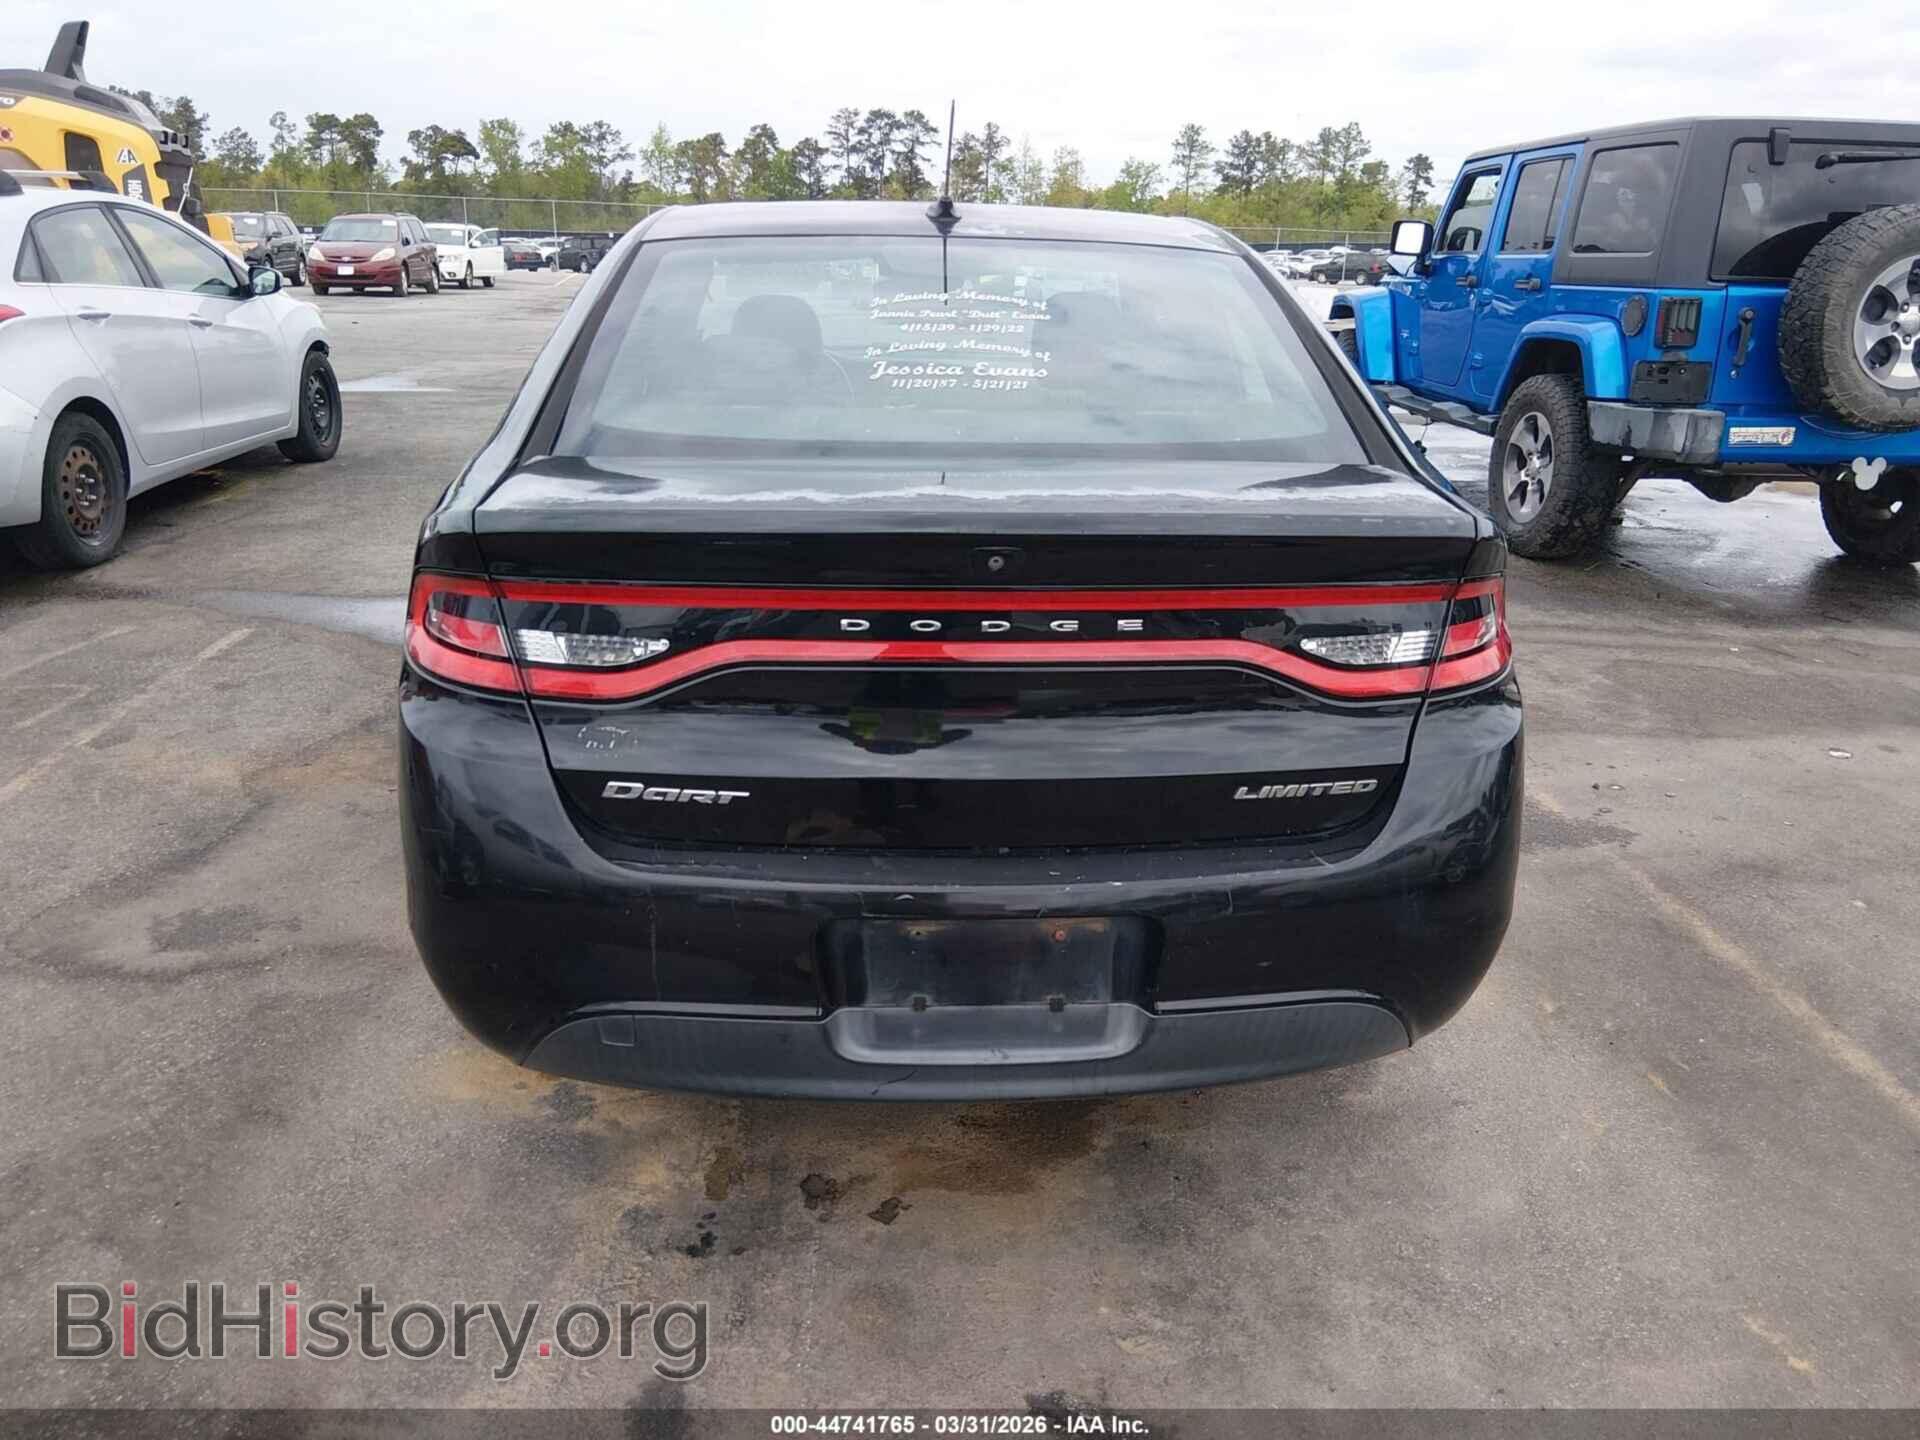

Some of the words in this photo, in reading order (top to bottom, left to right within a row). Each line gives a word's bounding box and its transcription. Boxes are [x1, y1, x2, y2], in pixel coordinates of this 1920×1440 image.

[870, 296, 888, 308] In
[892, 291, 949, 304] Loving
[954, 291, 1028, 308] Memory
[1032, 300, 1048, 312] of
[1012, 311, 1052, 320] Evans
[864, 346, 882, 360] In
[886, 339, 946, 353] Loving
[953, 339, 1032, 358] Memory
[1035, 351, 1051, 363] of
[869, 360, 965, 380] Jessica
[972, 361, 1049, 378] Evans
[840, 618, 1144, 632] DODGE
[1233, 779, 1378, 800] LIMITED
